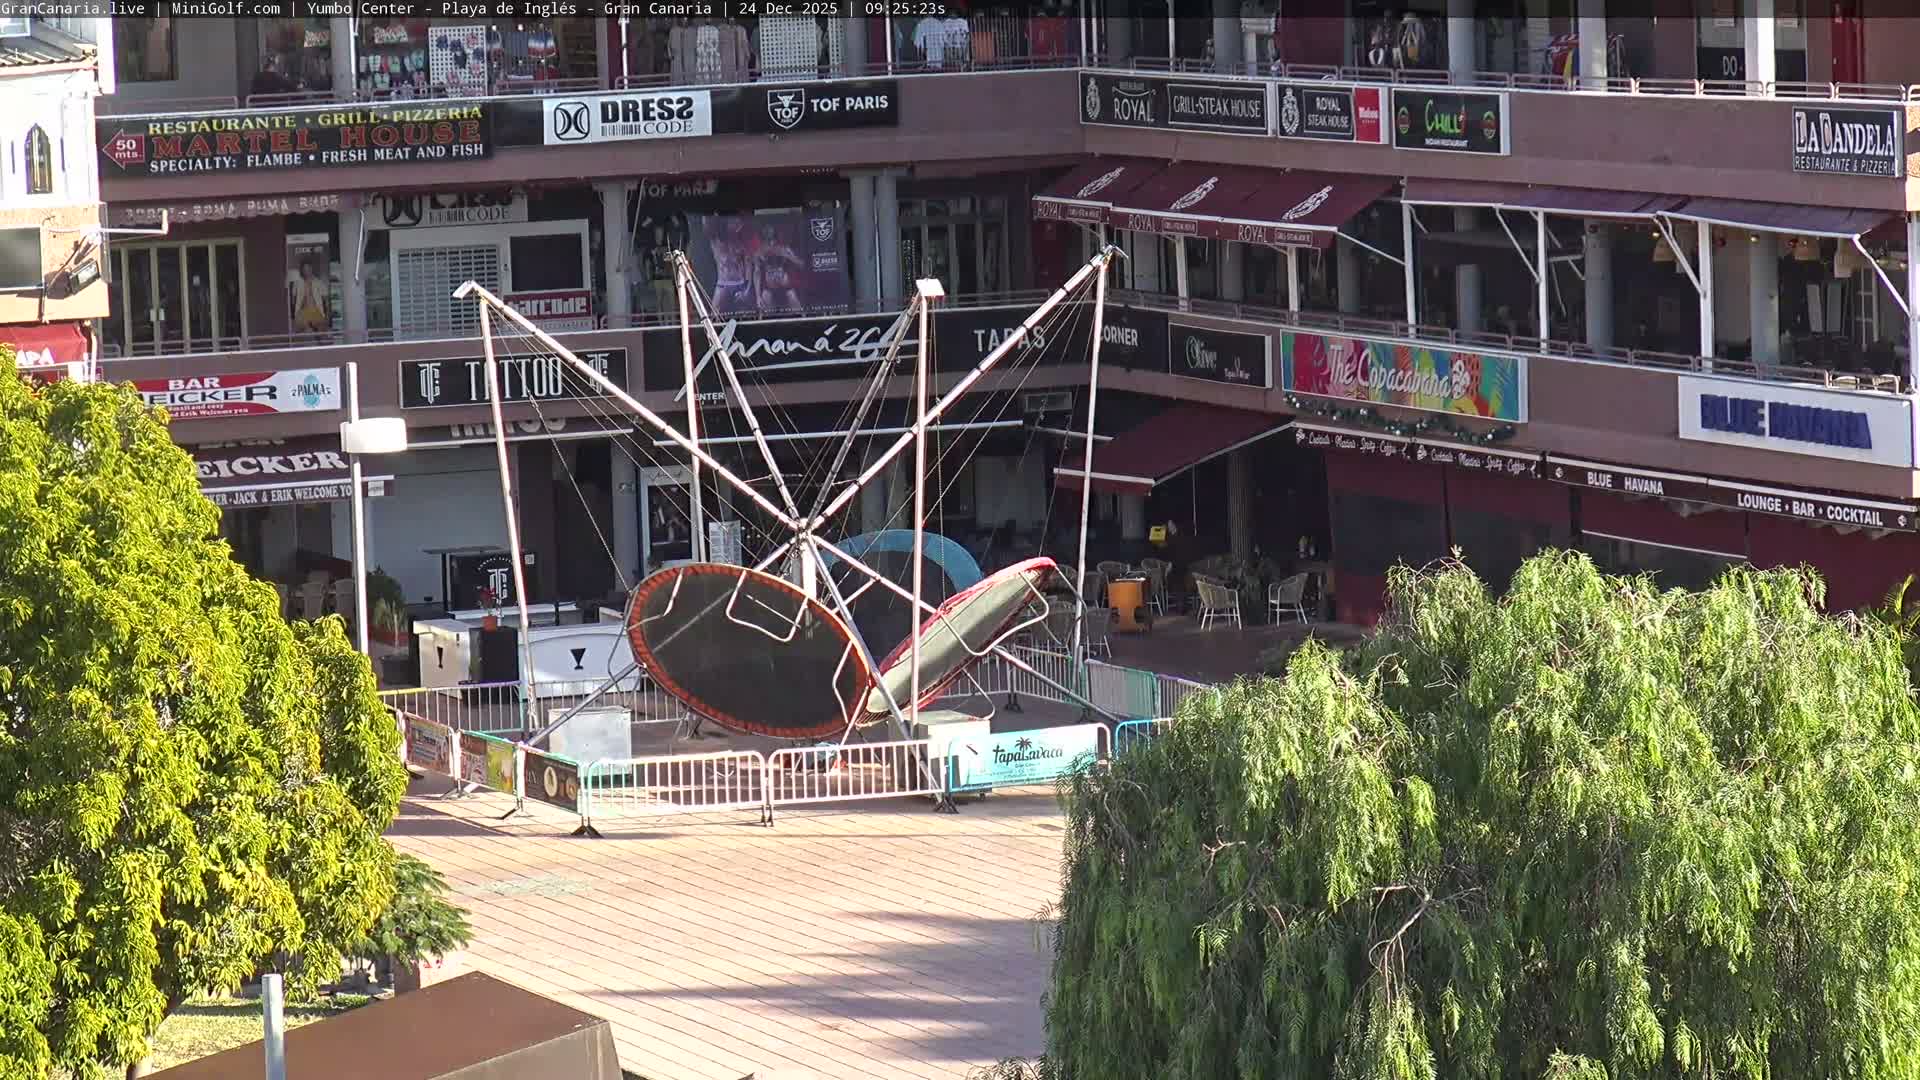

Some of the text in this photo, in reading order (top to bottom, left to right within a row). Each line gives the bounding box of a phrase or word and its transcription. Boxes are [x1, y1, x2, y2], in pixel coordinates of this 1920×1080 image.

[774, 107, 799, 119] TOF
[811, 95, 889, 112] TOF PARIS
[1114, 97, 1155, 121] ROYAL
[1199, 97, 1230, 116] STEAK
[1231, 99, 1261, 118] HOUSE
[1315, 97, 1341, 112] ROYAL
[149, 105, 483, 135] RESTAURANTE GRILL PIZZERIA
[643, 121, 693, 134] CODE
[1307, 113, 1327, 127] STEAK
[1328, 115, 1349, 128] HOUSE
[152, 120, 481, 159] MARTEL HOUSE
[1819, 113, 1895, 156] CANDELA
[116, 139, 136, 151] 50
[150, 143, 483, 173] SPECIALTY: FLAMBE FRESH MEAT AND FISH
[1795, 156, 1849, 171] RESTAURANTE
[1860, 160, 1895, 174] PIZZERIA
[1037, 201, 1062, 220] ROYAL
[1128, 214, 1157, 232] ROYAL
[1238, 225, 1268, 243] ROYAL
[1100, 325, 1138, 347] ORNER
[168, 377, 221, 390] BAR
[1357, 349, 1451, 398] Copacabana
[140, 385, 278, 405] EICKER
[694, 392, 725, 401] ENTER
[1700, 394, 1765, 437] BLUE
[1587, 471, 1664, 495] BLUE HAVANA
[232, 490, 257, 504] JACK
[271, 488, 293, 502] ERIK
[294, 484, 341, 500] WELCOME
[1737, 493, 1884, 526] LOUNGE BAR COCKTAIL
